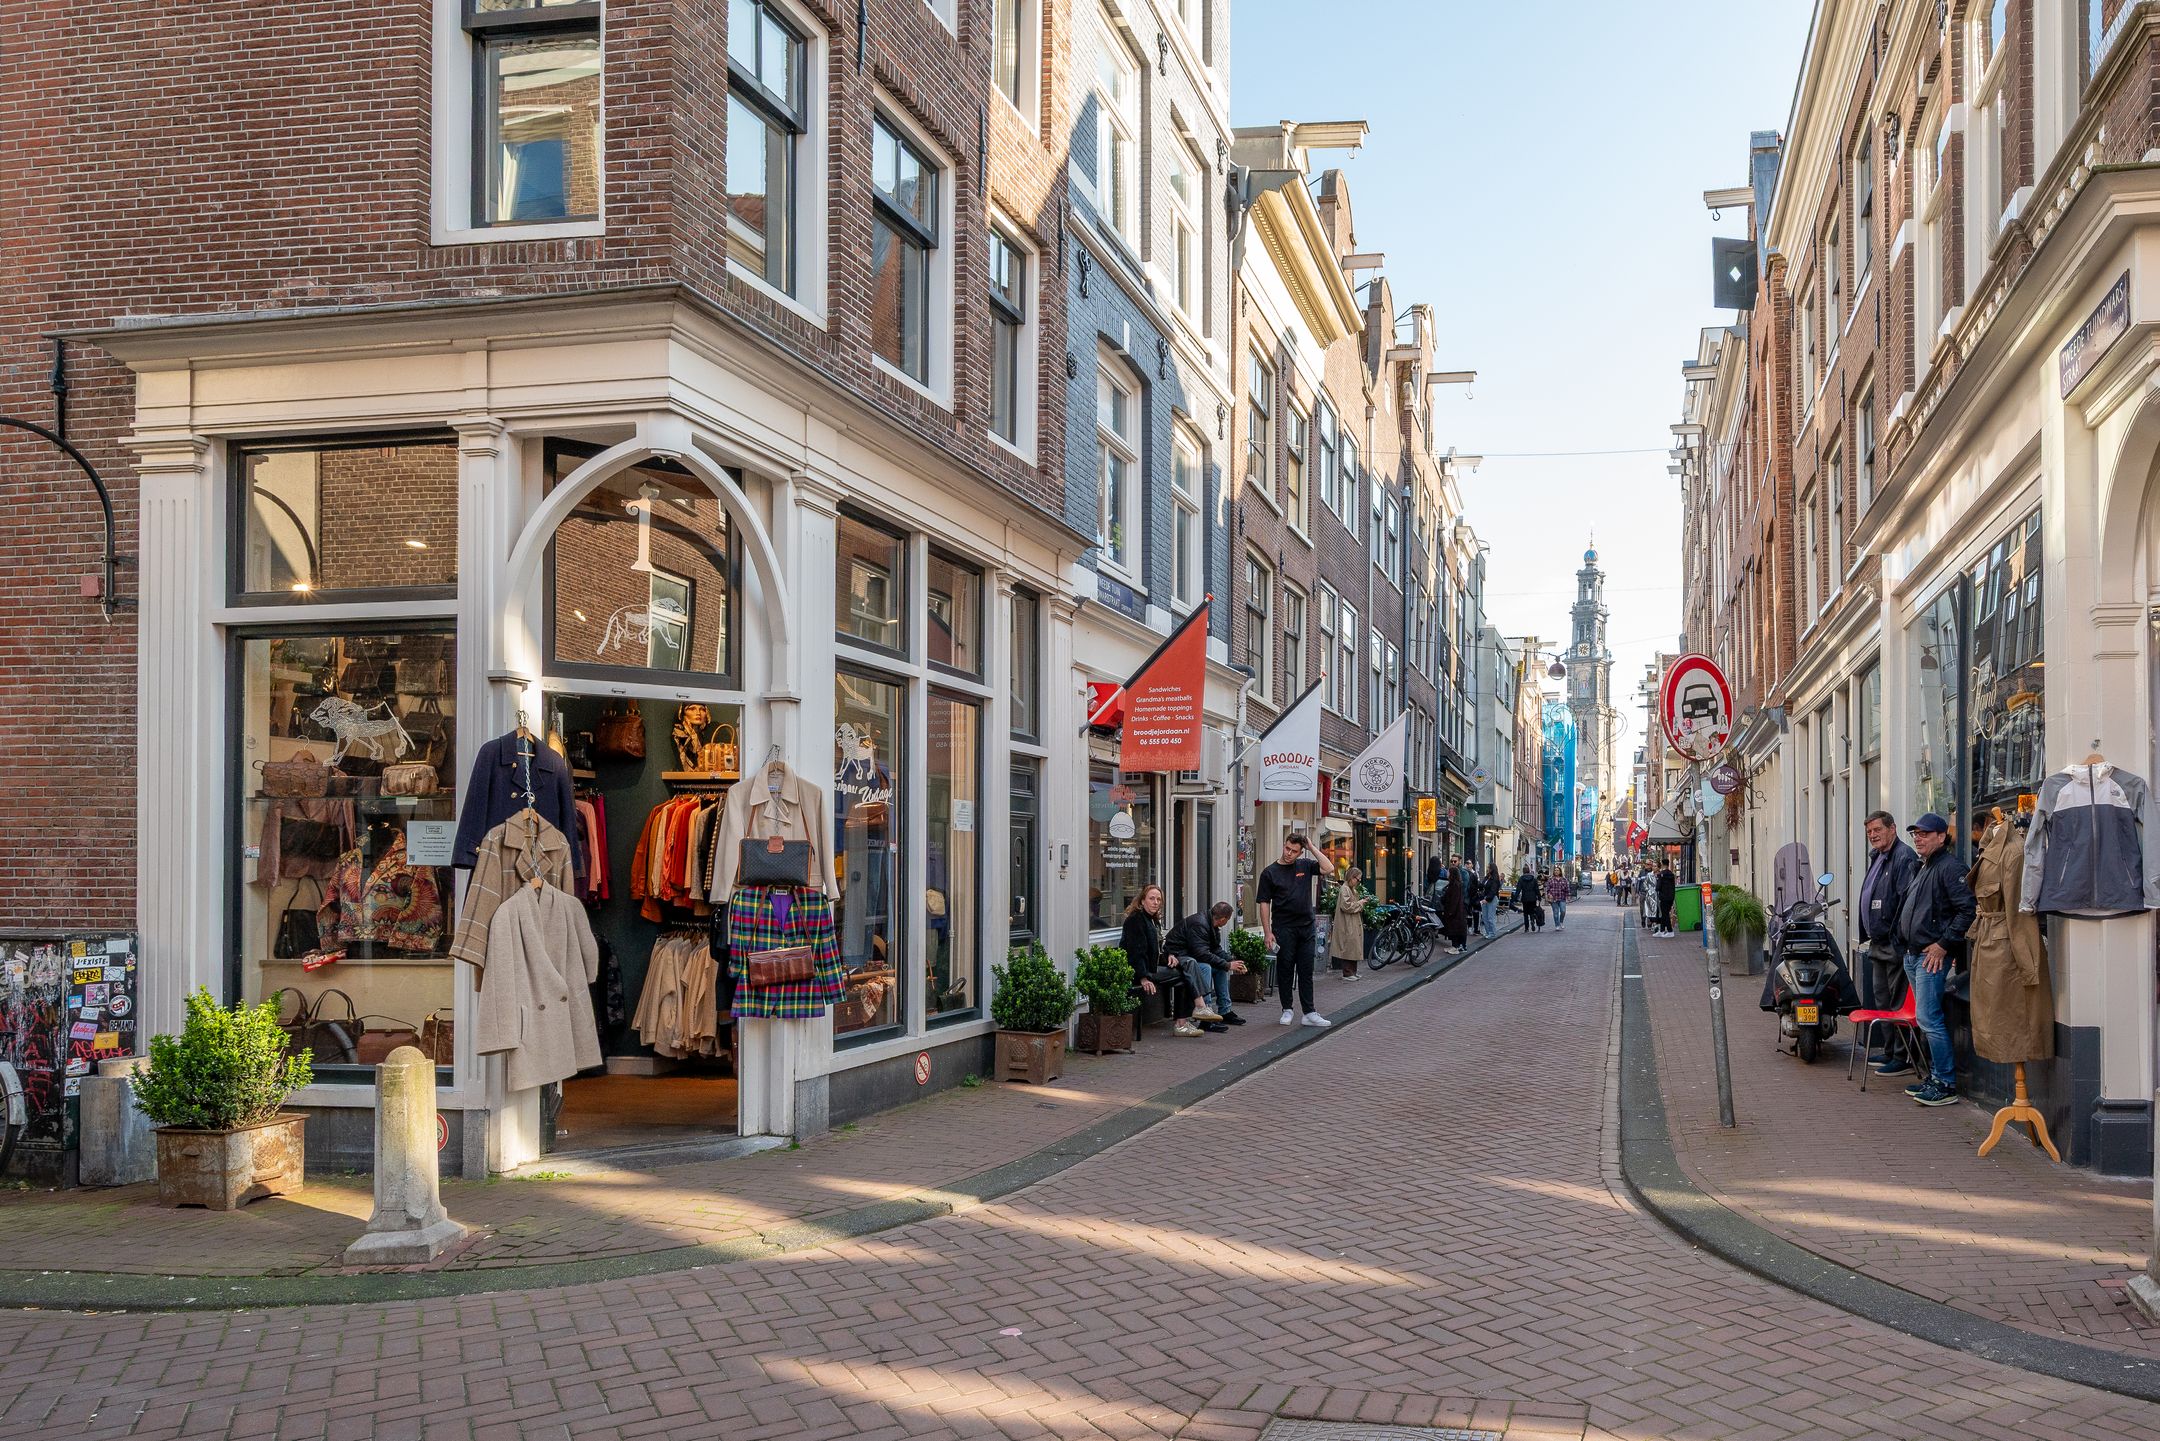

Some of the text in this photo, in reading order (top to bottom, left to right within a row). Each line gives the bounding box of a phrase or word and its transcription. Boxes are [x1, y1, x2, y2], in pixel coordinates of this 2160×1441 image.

[2061, 282, 2124, 369] TWEEDE TUINDWARS
[2062, 356, 2082, 391] STRAAT
[1133, 728, 1190, 737] broodjejordaan.nl
[1263, 752, 1315, 768] BROODJE
[1364, 759, 1391, 769] KICK OFF
[1363, 780, 1391, 791] VINTAGE
